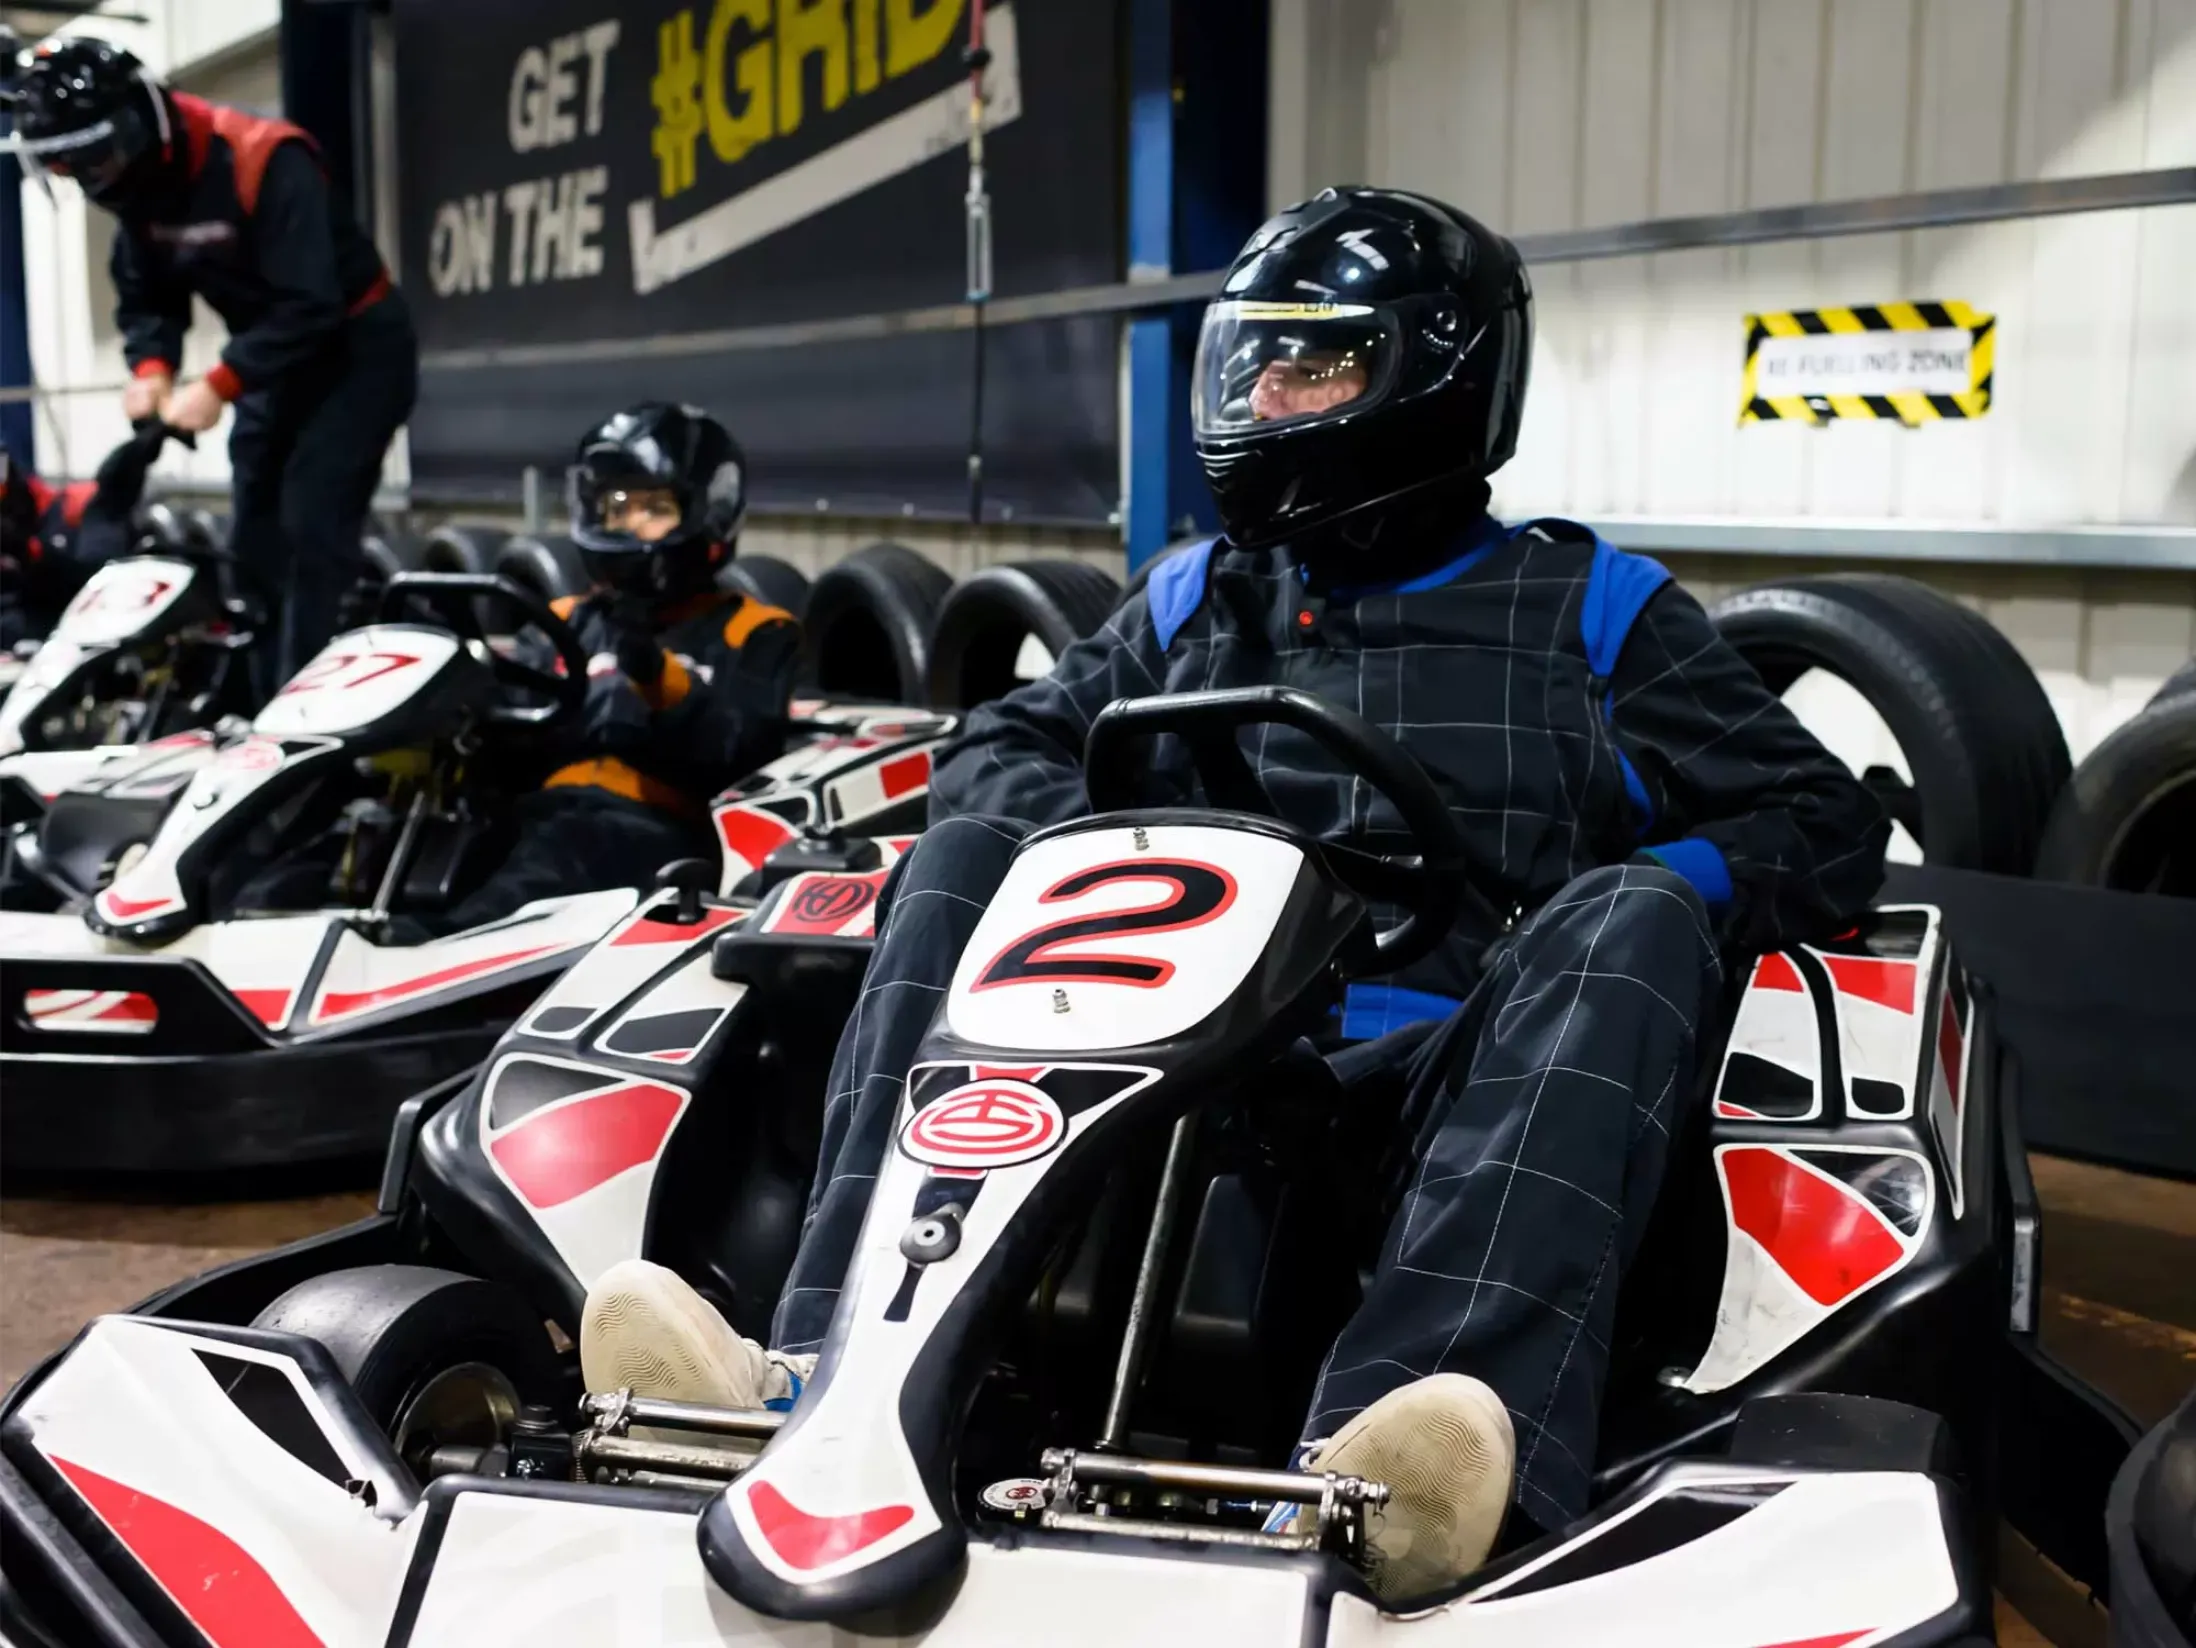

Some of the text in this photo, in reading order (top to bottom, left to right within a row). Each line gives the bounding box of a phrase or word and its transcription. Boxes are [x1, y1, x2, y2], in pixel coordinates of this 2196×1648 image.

[508, 19, 621, 153] GET
[428, 165, 609, 295] ON THE
[1907, 348, 1967, 374] ZONE
[280, 651, 422, 694] 27
[969, 857, 1238, 993] 2
